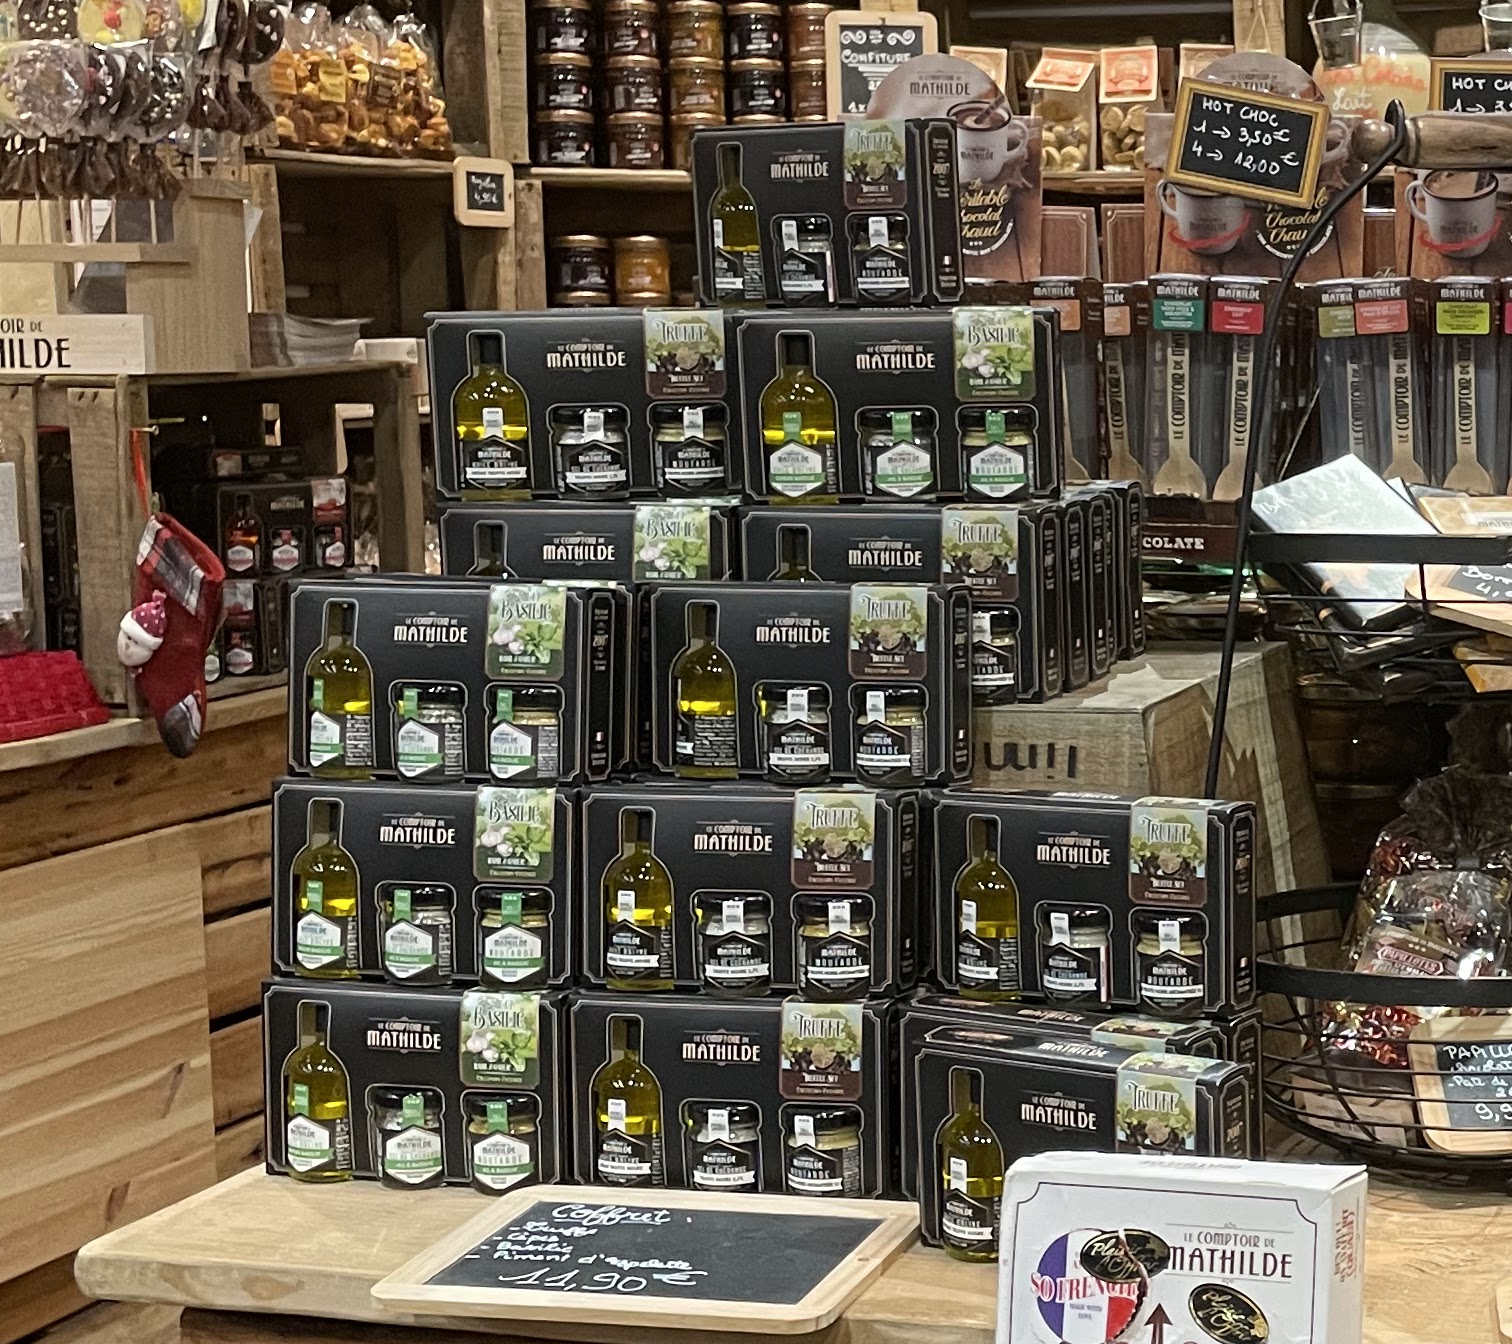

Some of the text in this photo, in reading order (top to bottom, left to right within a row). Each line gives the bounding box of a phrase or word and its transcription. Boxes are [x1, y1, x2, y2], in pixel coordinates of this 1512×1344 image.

[910, 82, 970, 95] MATHILDE
[1452, 76, 1486, 92] HOT
[770, 160, 829, 180] MATHILDE
[546, 349, 627, 369] MATHILDE
[856, 350, 936, 370] MATHILDE
[848, 549, 923, 568] MATHILDE
[394, 624, 468, 645] MATHILDE
[756, 624, 831, 645] MATHILDE
[694, 832, 772, 854] MATHILDE
[1037, 844, 1111, 866] MATHILDE
[367, 1029, 442, 1051] MATHILDE
[682, 1042, 761, 1063] MATHILDE
[1021, 1106, 1097, 1130] MATHILDE
[1198, 1230, 1261, 1248] COMPTOIR
[1264, 1238, 1276, 1248] DE
[1166, 1245, 1293, 1279] MATHILDE
